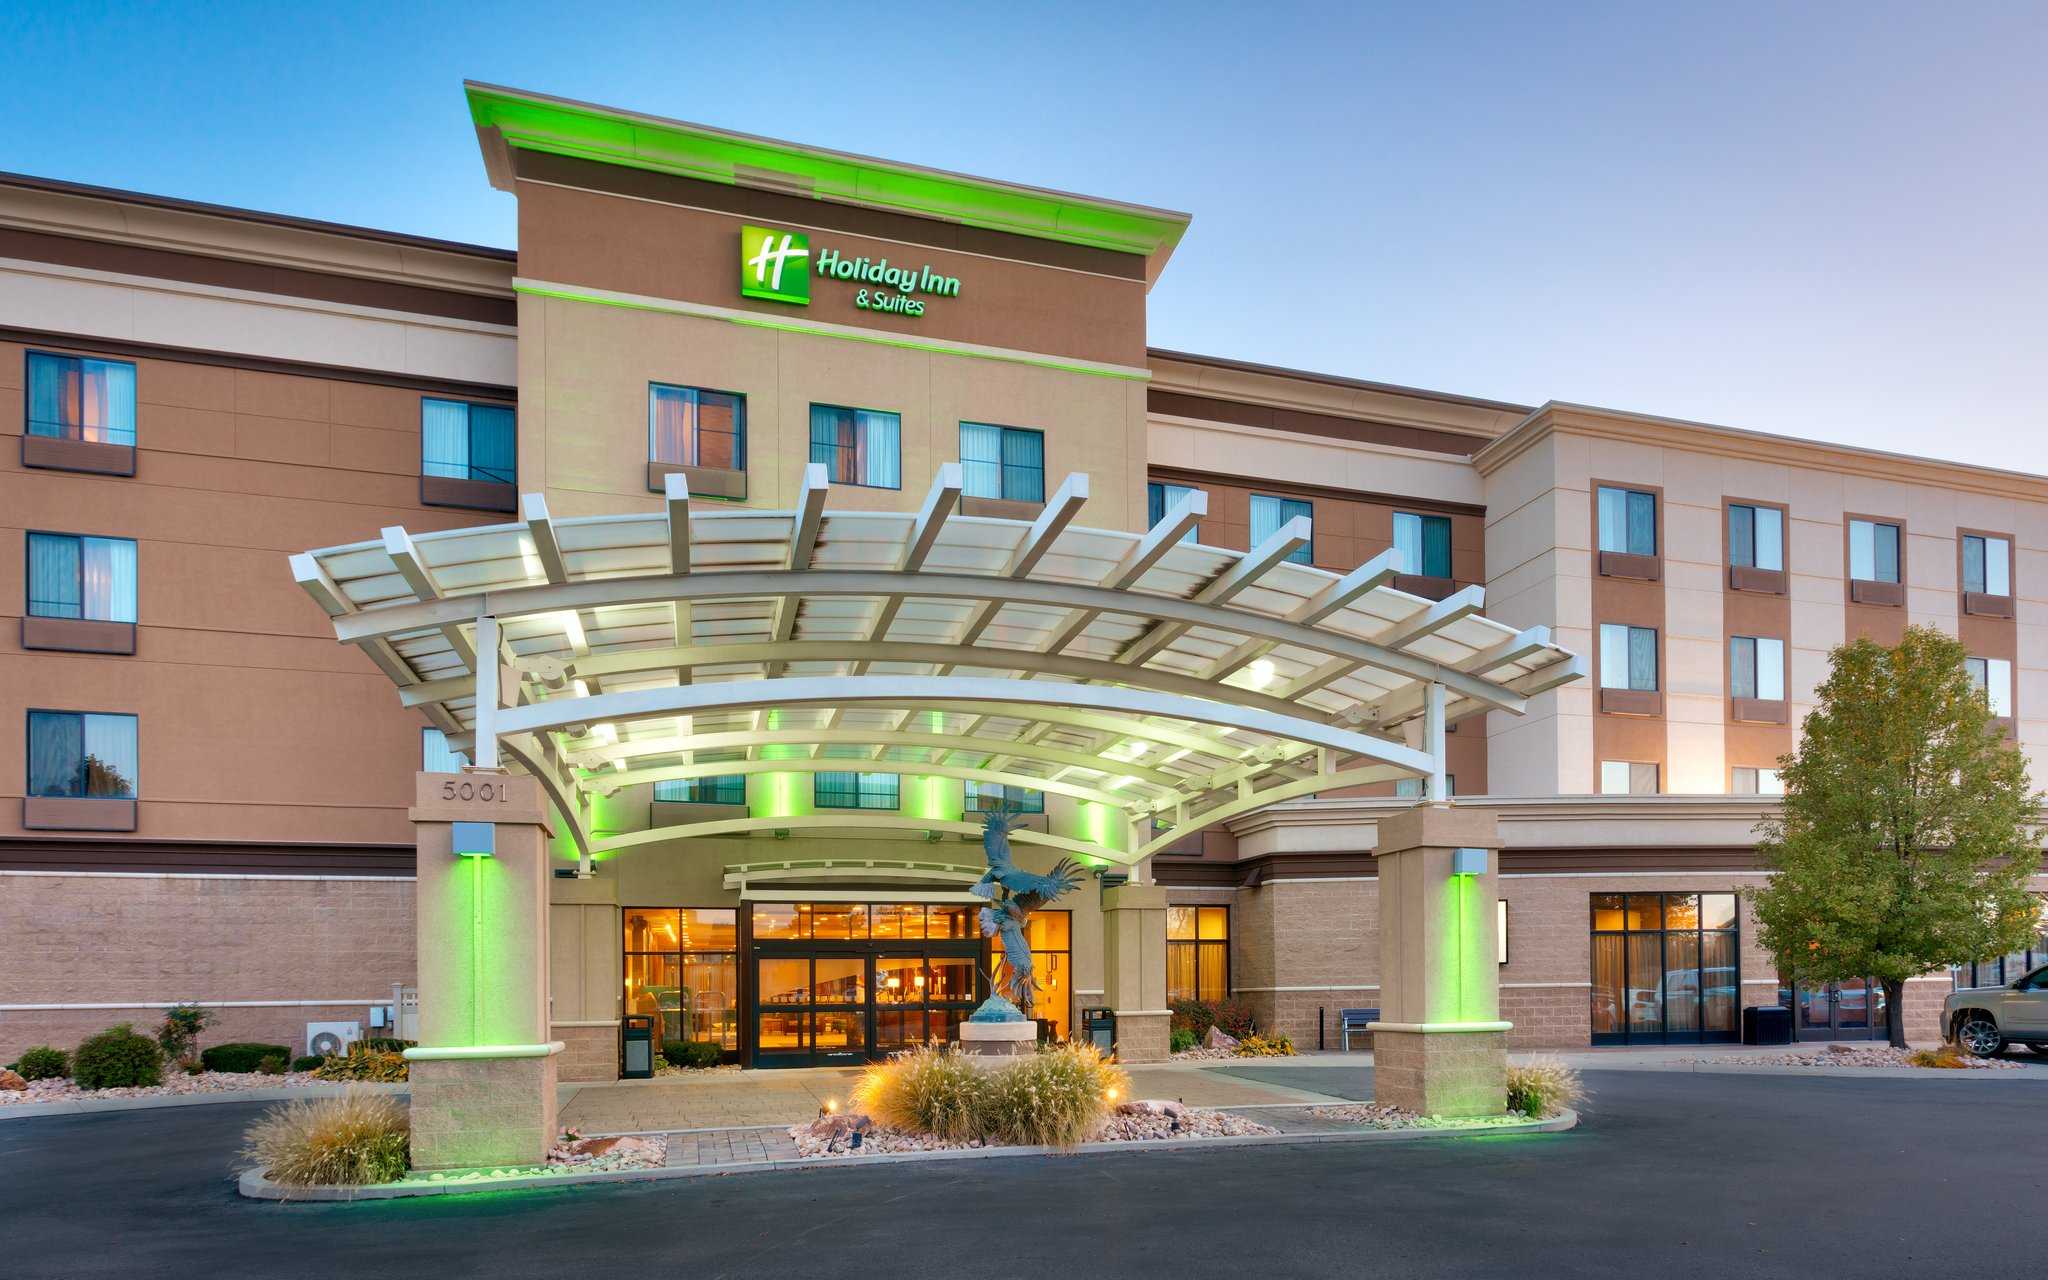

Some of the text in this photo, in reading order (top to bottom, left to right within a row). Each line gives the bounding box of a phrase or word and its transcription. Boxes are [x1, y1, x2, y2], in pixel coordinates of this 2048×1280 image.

[816, 248, 961, 297] Holiday Inn
[856, 288, 925, 316] & Suites
[442, 781, 508, 802] 5001
